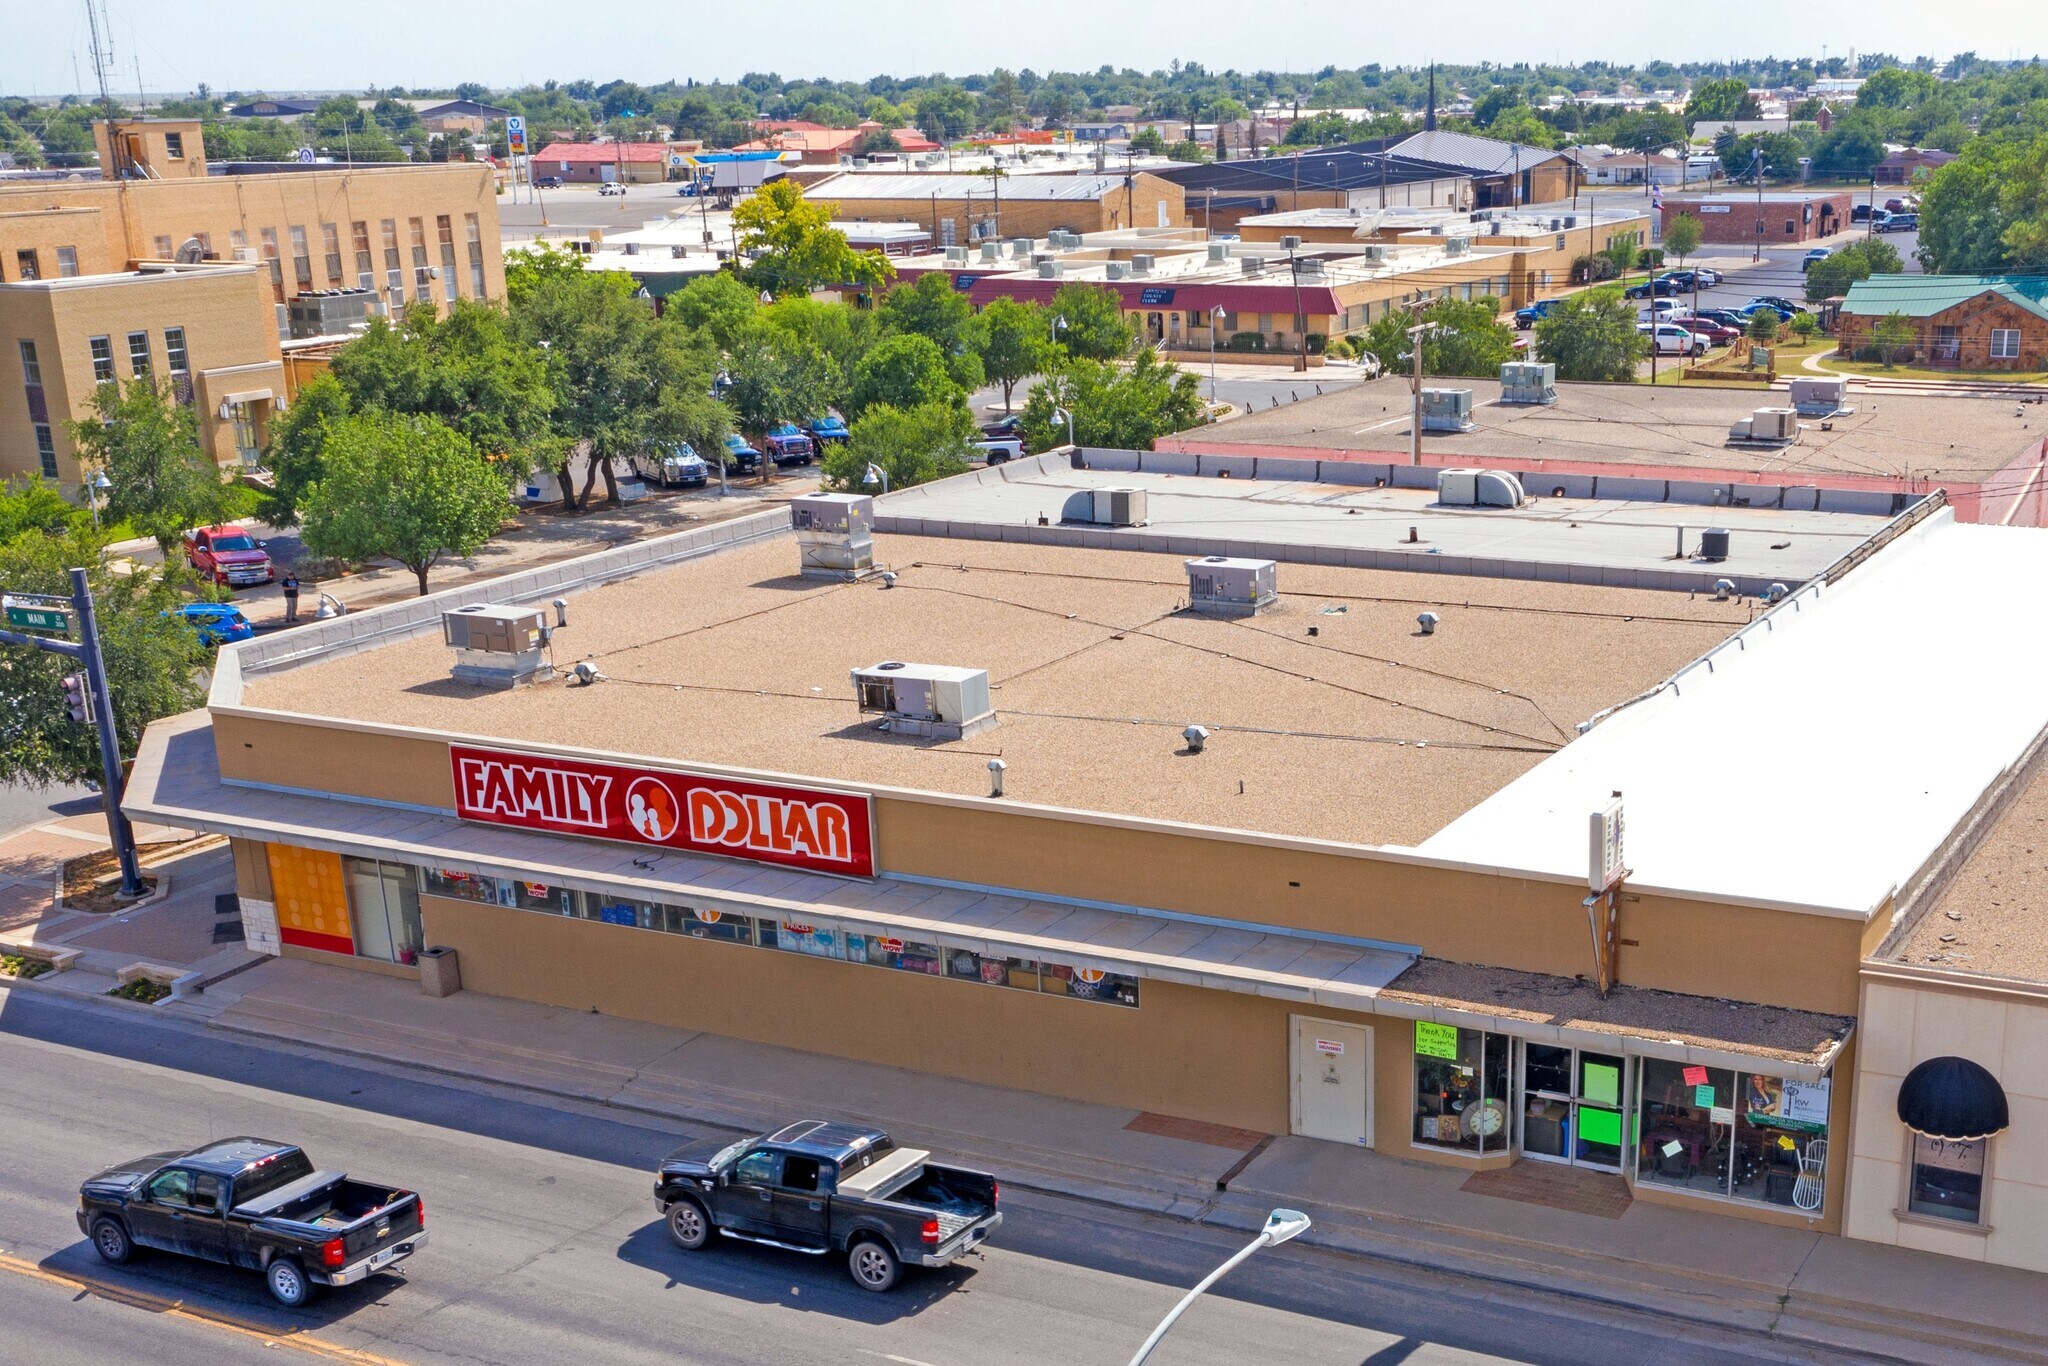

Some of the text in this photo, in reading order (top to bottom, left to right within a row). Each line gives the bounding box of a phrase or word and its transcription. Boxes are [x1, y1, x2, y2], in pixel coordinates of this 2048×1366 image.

[27, 613, 47, 625] MAIN
[460, 757, 852, 863] FAMILY DOLLAR
[528, 889, 547, 898] WOW!
[786, 922, 810, 932] PRICES
[881, 943, 904, 953] WOW!
[1419, 1023, 1440, 1036] Thank
[1785, 1079, 1827, 1092] FOR SALE
[1794, 1096, 1810, 1106] kw
